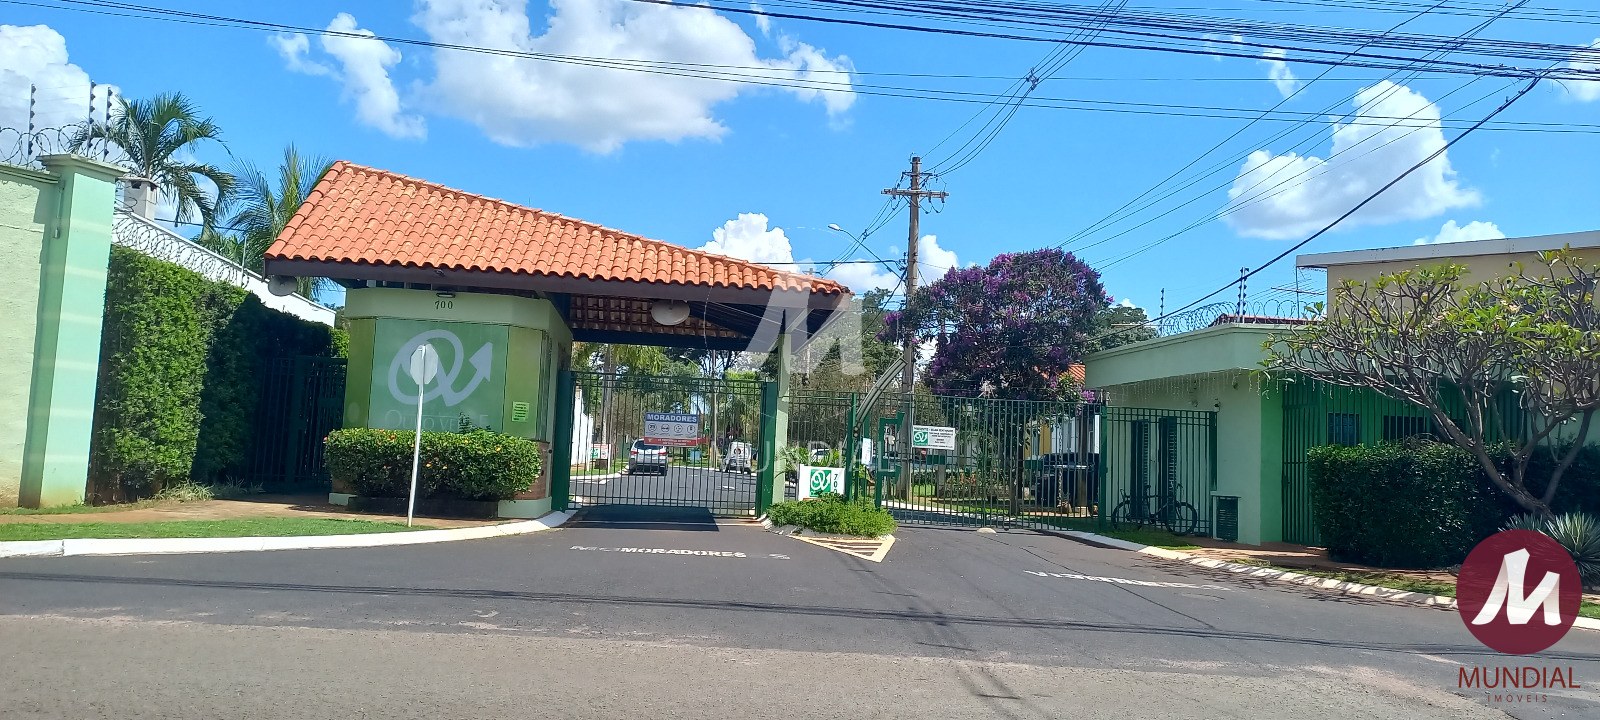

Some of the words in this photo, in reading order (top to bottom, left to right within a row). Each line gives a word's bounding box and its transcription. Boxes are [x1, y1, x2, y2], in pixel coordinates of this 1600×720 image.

[434, 300, 453, 310] 700
[646, 413, 698, 423] MORADORES
[619, 547, 748, 558] MORADORES
